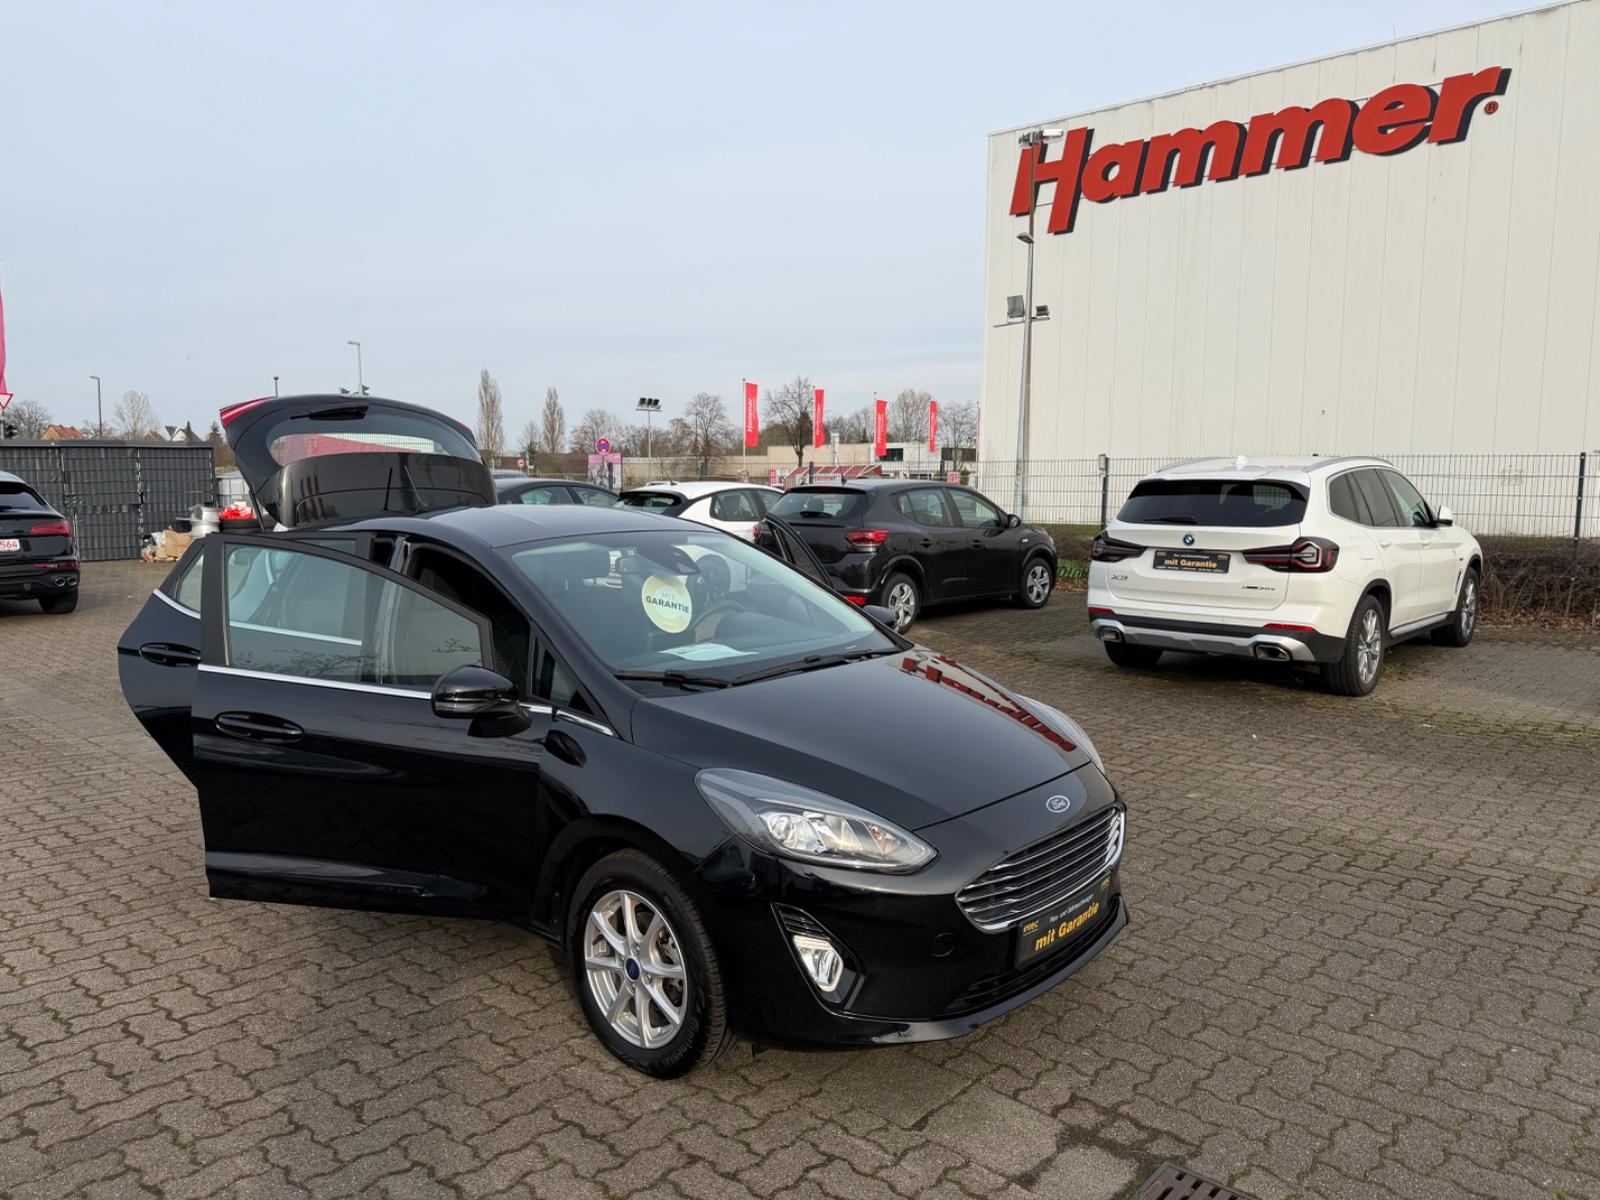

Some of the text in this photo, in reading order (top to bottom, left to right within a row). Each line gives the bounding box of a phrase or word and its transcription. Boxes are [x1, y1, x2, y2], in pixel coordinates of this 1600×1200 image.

[1009, 66, 1511, 234] Hammer
[1164, 558, 1217, 568] mit Garantie
[646, 595, 689, 613] GARANTIE
[1034, 928, 1056, 951] mit
[1058, 901, 1100, 938] Garantie
